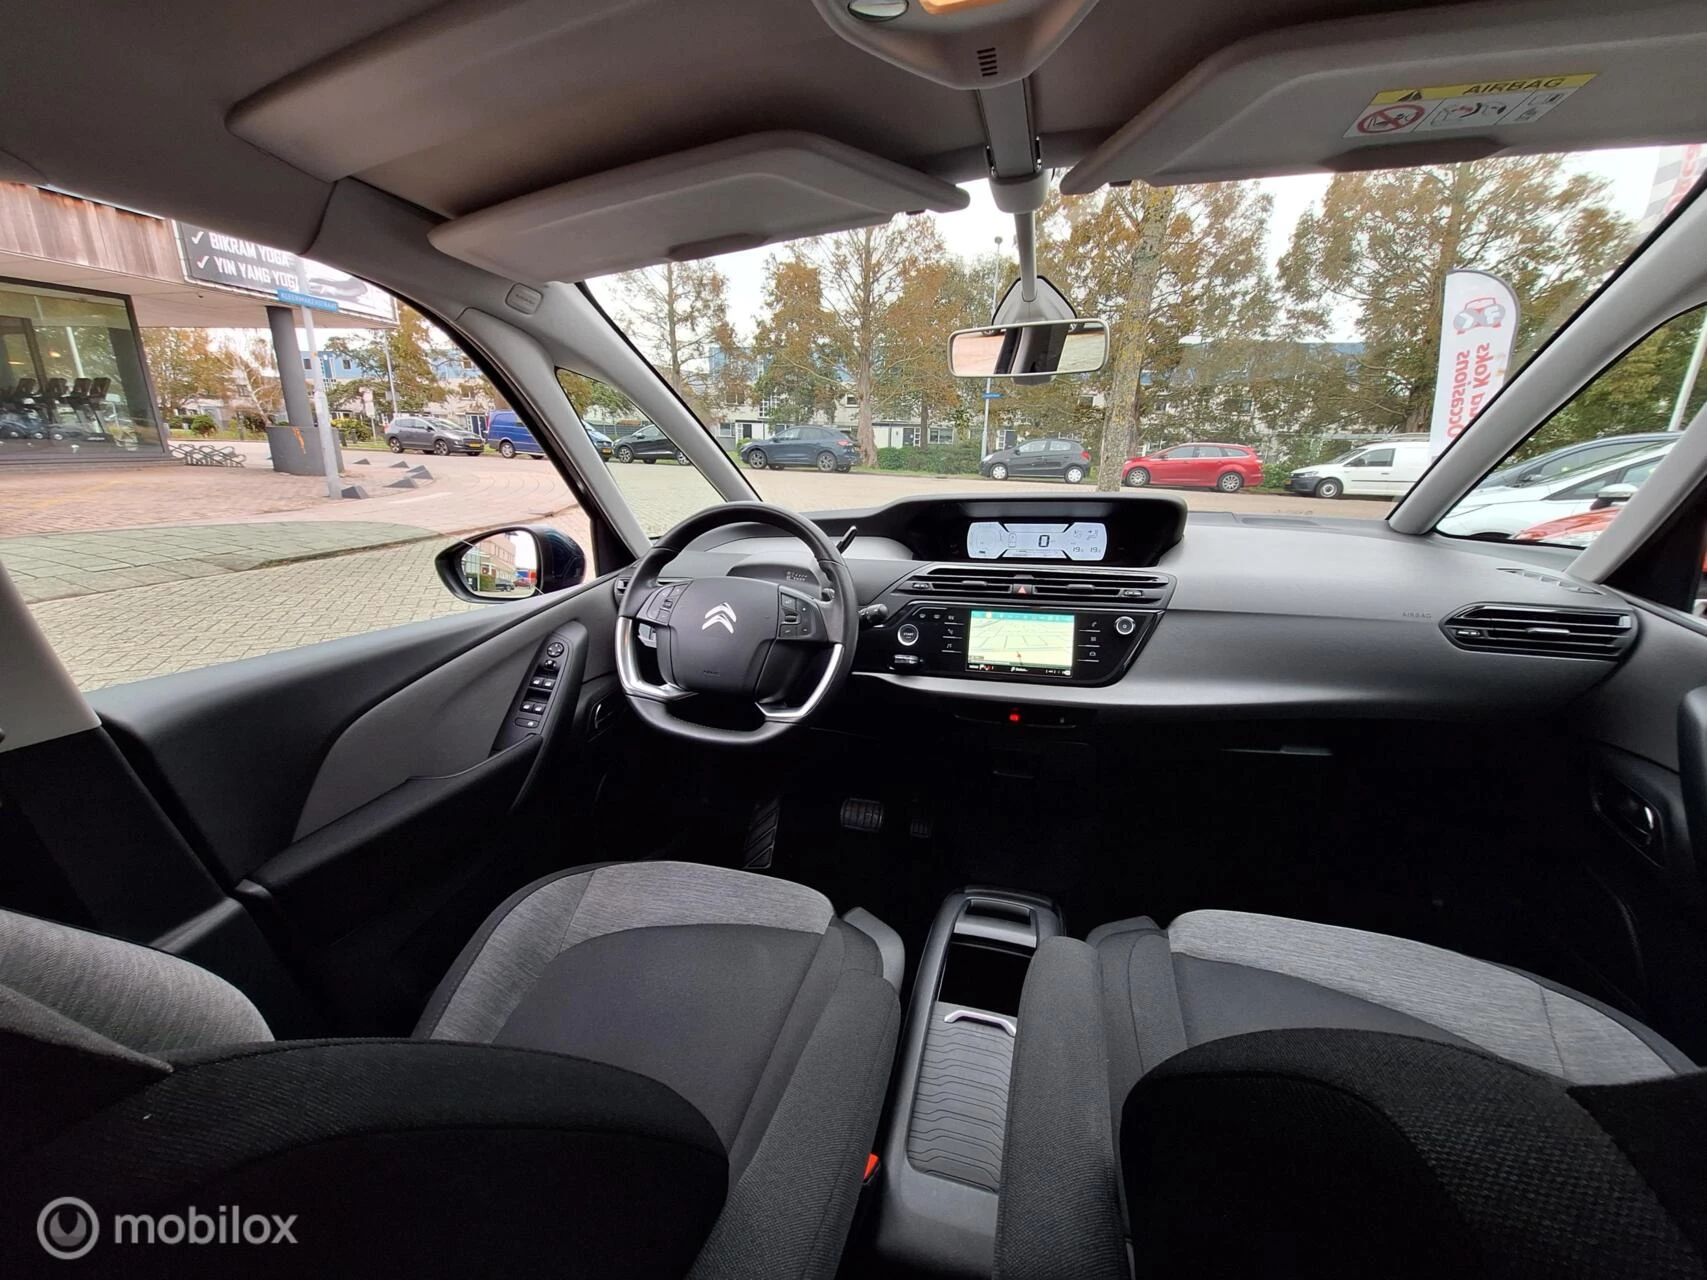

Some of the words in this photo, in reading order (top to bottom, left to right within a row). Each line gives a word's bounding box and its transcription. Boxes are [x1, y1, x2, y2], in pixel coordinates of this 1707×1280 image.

[1462, 78, 1567, 95] AIRBAG
[208, 231, 257, 259] BIKRAM
[257, 244, 290, 268] YOGA
[213, 255, 238, 277] YIN
[237, 262, 272, 284] YANG
[1038, 534, 1050, 548] 0
